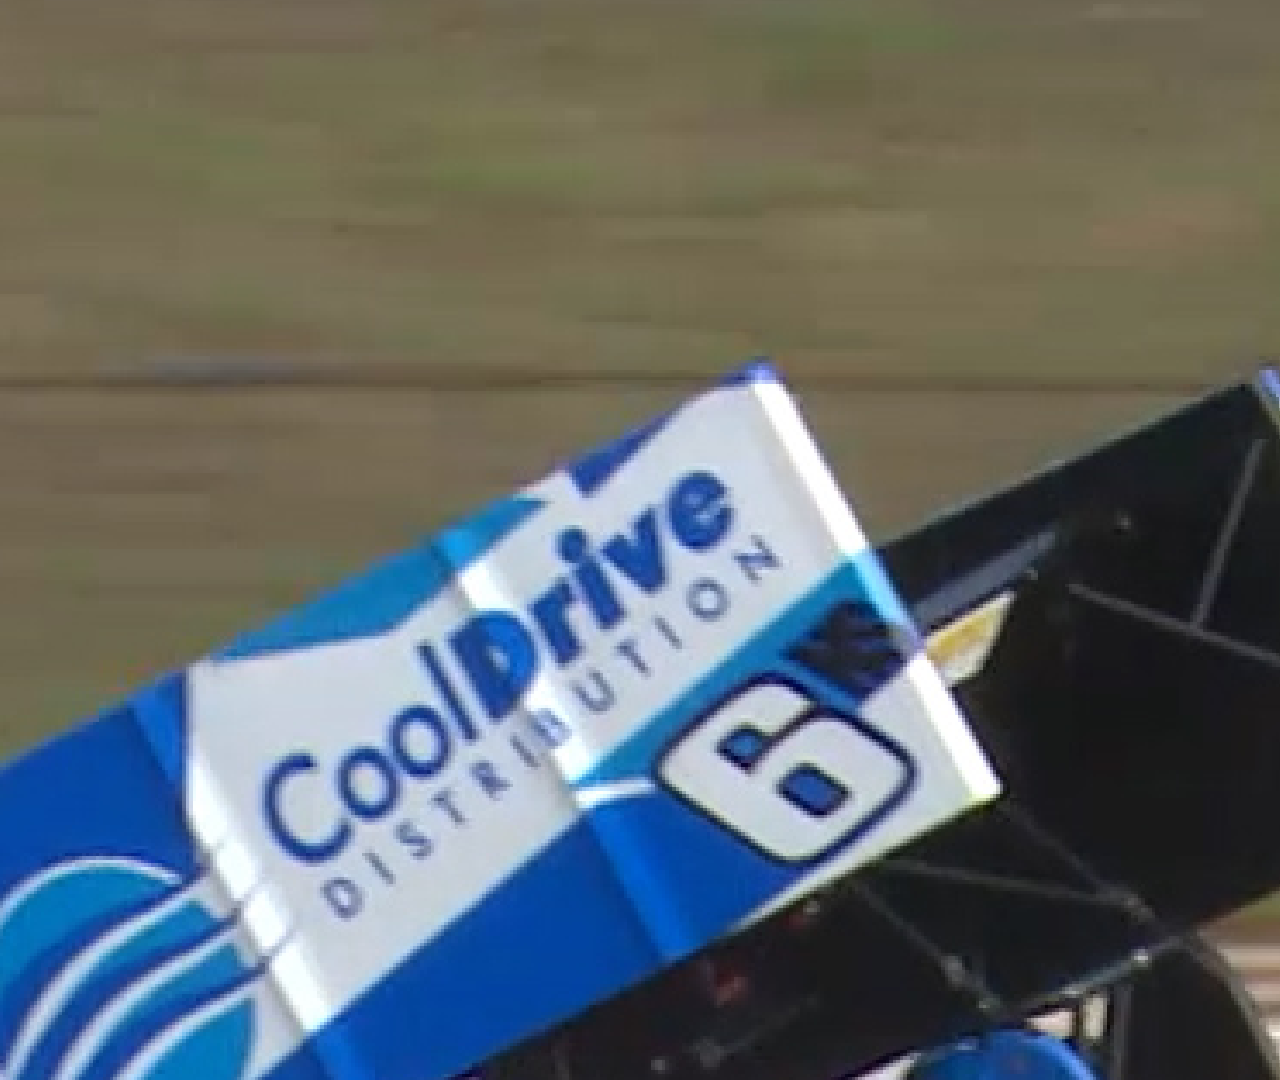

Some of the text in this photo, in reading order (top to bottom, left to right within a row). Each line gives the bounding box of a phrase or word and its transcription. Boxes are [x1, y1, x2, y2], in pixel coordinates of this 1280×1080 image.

[262, 471, 732, 863] CoolDrive
[324, 534, 782, 918] DISTRIBUTION
[654, 675, 912, 864] 6
